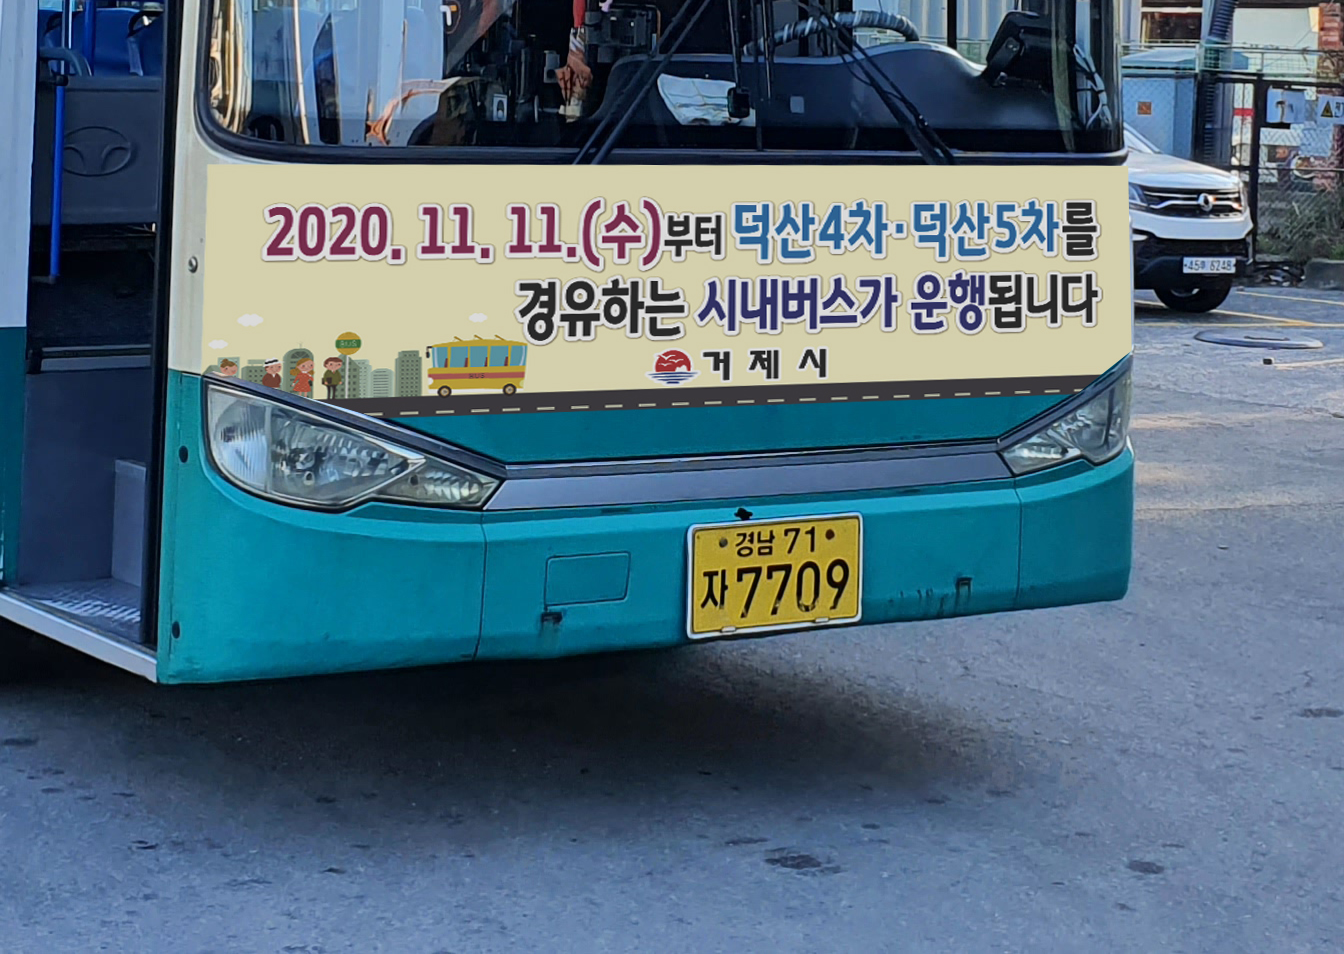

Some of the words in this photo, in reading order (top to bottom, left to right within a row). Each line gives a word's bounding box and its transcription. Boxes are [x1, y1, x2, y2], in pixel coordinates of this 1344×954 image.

[265, 205, 402, 261] 2020.
[420, 206, 490, 260] 11.
[518, 279, 685, 341] 경유하는
[697, 276, 898, 331] 시내버스가
[910, 273, 1099, 331] 운행됩니다
[735, 530, 775, 557] 경남
[783, 526, 816, 554] 71
